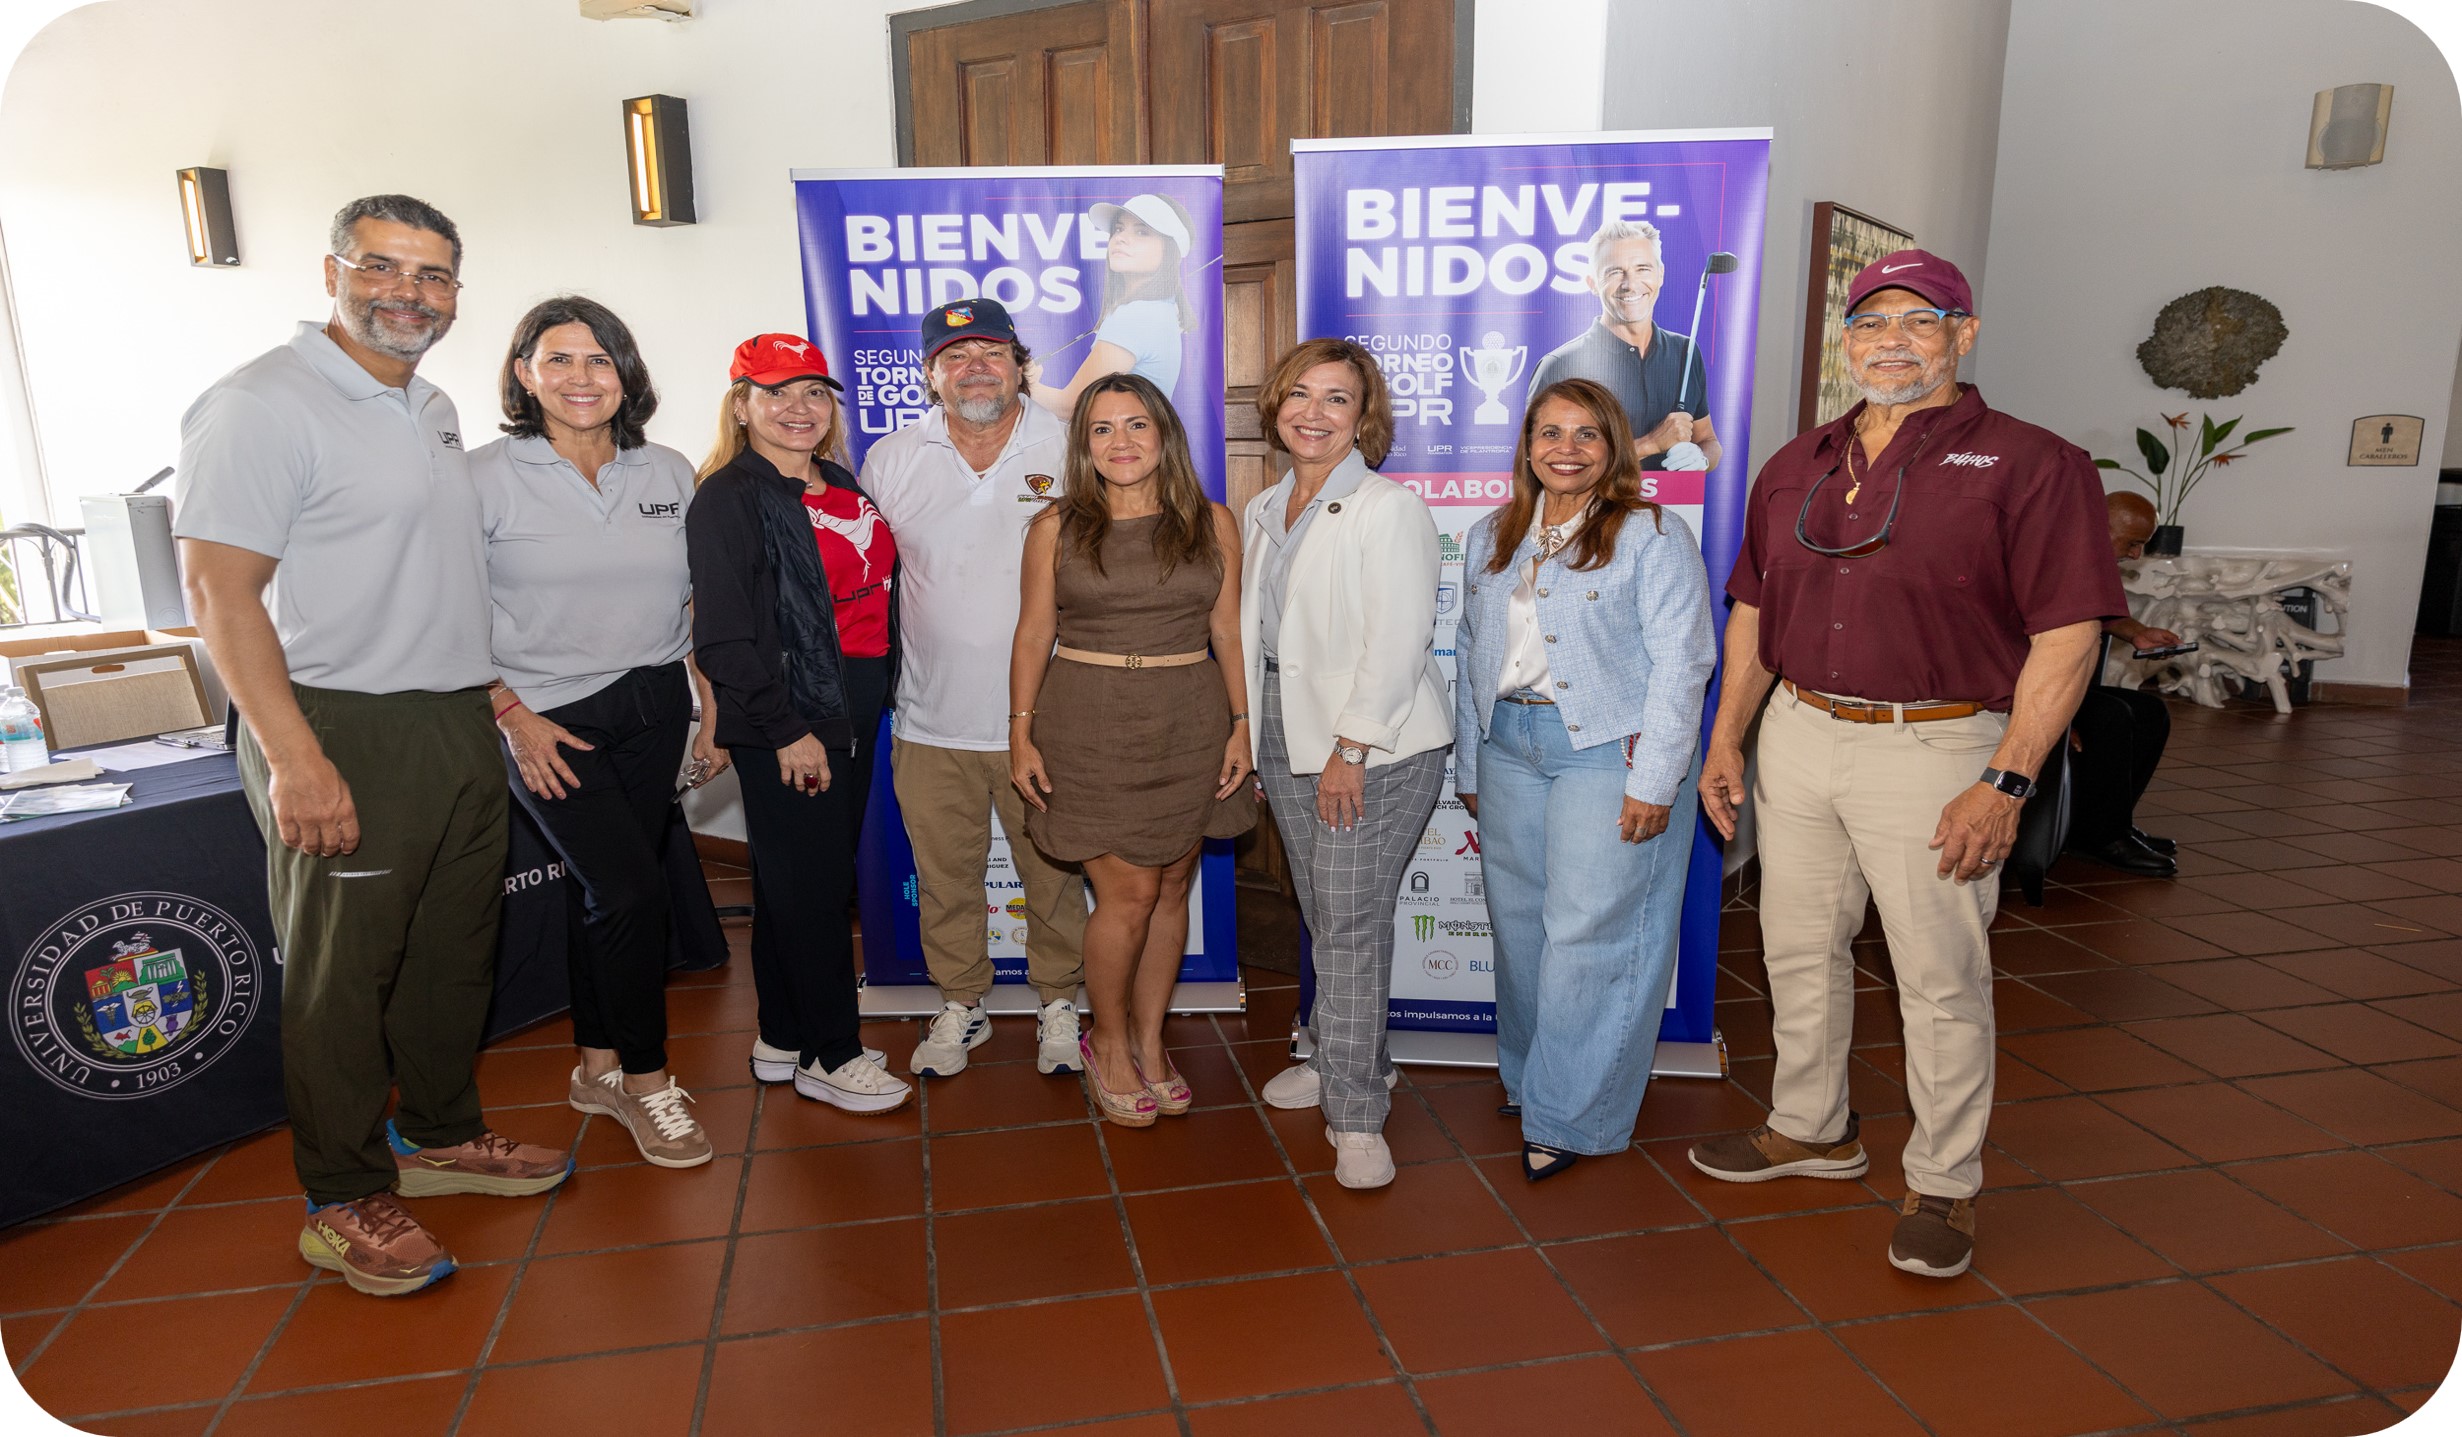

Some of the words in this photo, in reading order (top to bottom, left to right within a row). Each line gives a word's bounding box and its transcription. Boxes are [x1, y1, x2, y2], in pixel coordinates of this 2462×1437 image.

[1346, 182, 1680, 240] BIENVE-
[1346, 242, 1596, 298] NIDOS
[850, 266, 1082, 316] NIDOS
[853, 349, 923, 365] SEGUN
[1372, 352, 1454, 373] RNEO
[855, 366, 926, 385] TORN
[1385, 372, 1454, 396] OLF
[858, 391, 874, 401] DE
[859, 408, 926, 434] UP
[1390, 397, 1454, 426] PR
[1403, 479, 1515, 499] OLABO
[2283, 604, 2309, 613] TION
[503, 868, 543, 895] RTO
[546, 860, 566, 881] RI
[902, 881, 910, 900] HOLE
[909, 874, 918, 907] SPONSOR
[1438, 919, 1493, 931] MONSTE
[1428, 959, 1454, 971] MCC
[24, 913, 100, 1085] UNIVERSIDAD
[110, 901, 144, 921] DE
[155, 901, 248, 966] PUERTO
[218, 974, 251, 1036] RICO
[1404, 1009, 1471, 1020] impulsamos
[1482, 1012, 1493, 1021] la
[136, 1062, 182, 1089] 1903
[317, 1220, 351, 1258] HOKA
